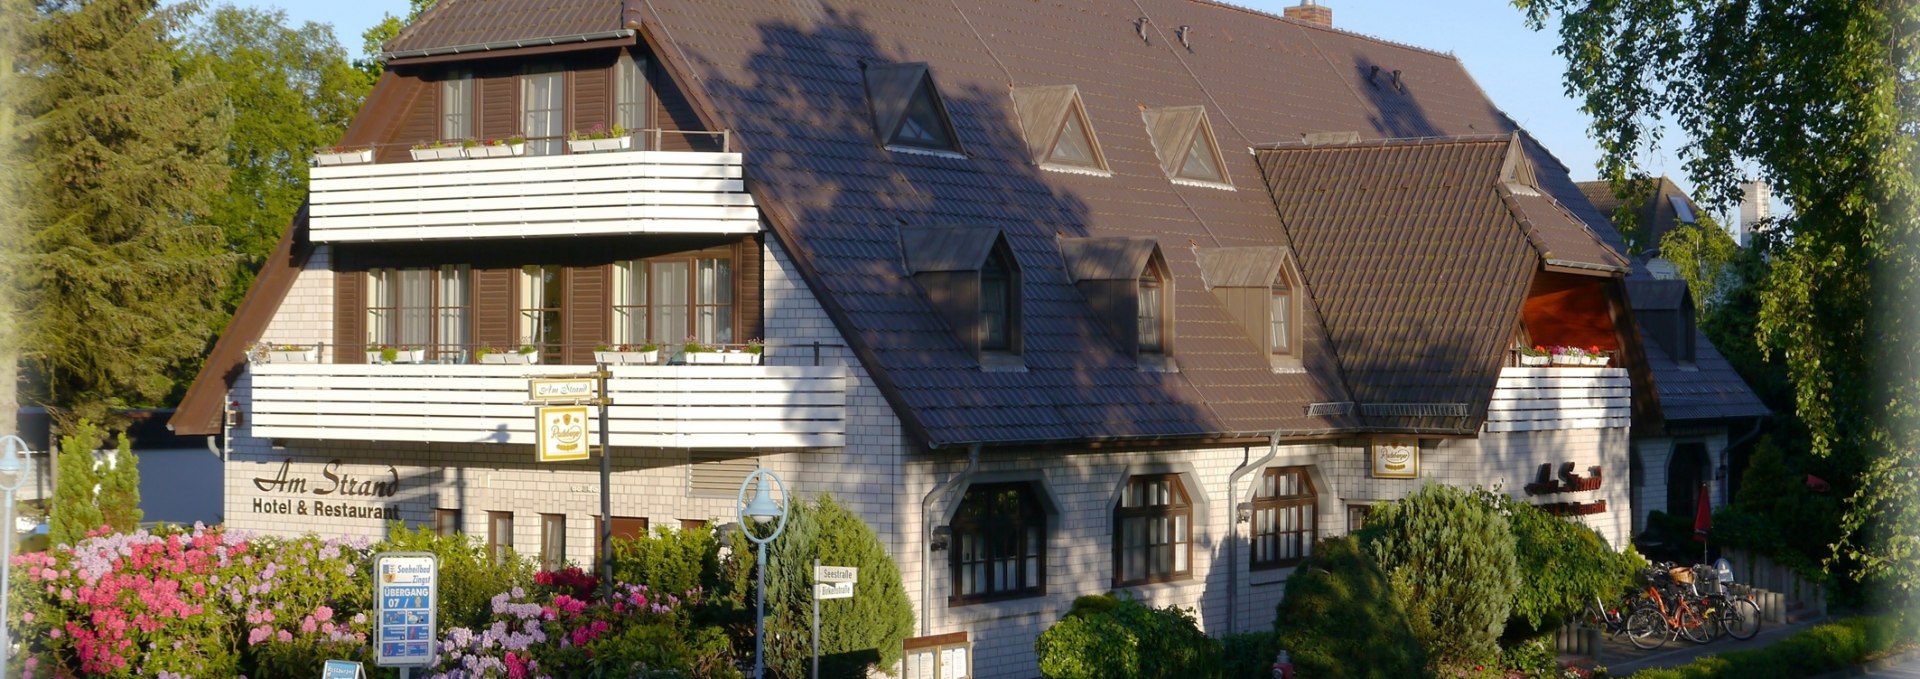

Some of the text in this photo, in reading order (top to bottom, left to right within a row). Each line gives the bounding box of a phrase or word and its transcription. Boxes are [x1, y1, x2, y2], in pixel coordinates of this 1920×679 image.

[560, 383, 588, 395] Strand
[253, 457, 399, 498] Am Strand
[253, 498, 400, 519] Hotel & Restaurant
[823, 569, 852, 579] Seestraße
[384, 587, 429, 597] ÜBERGANG
[388, 598, 400, 608] 07
